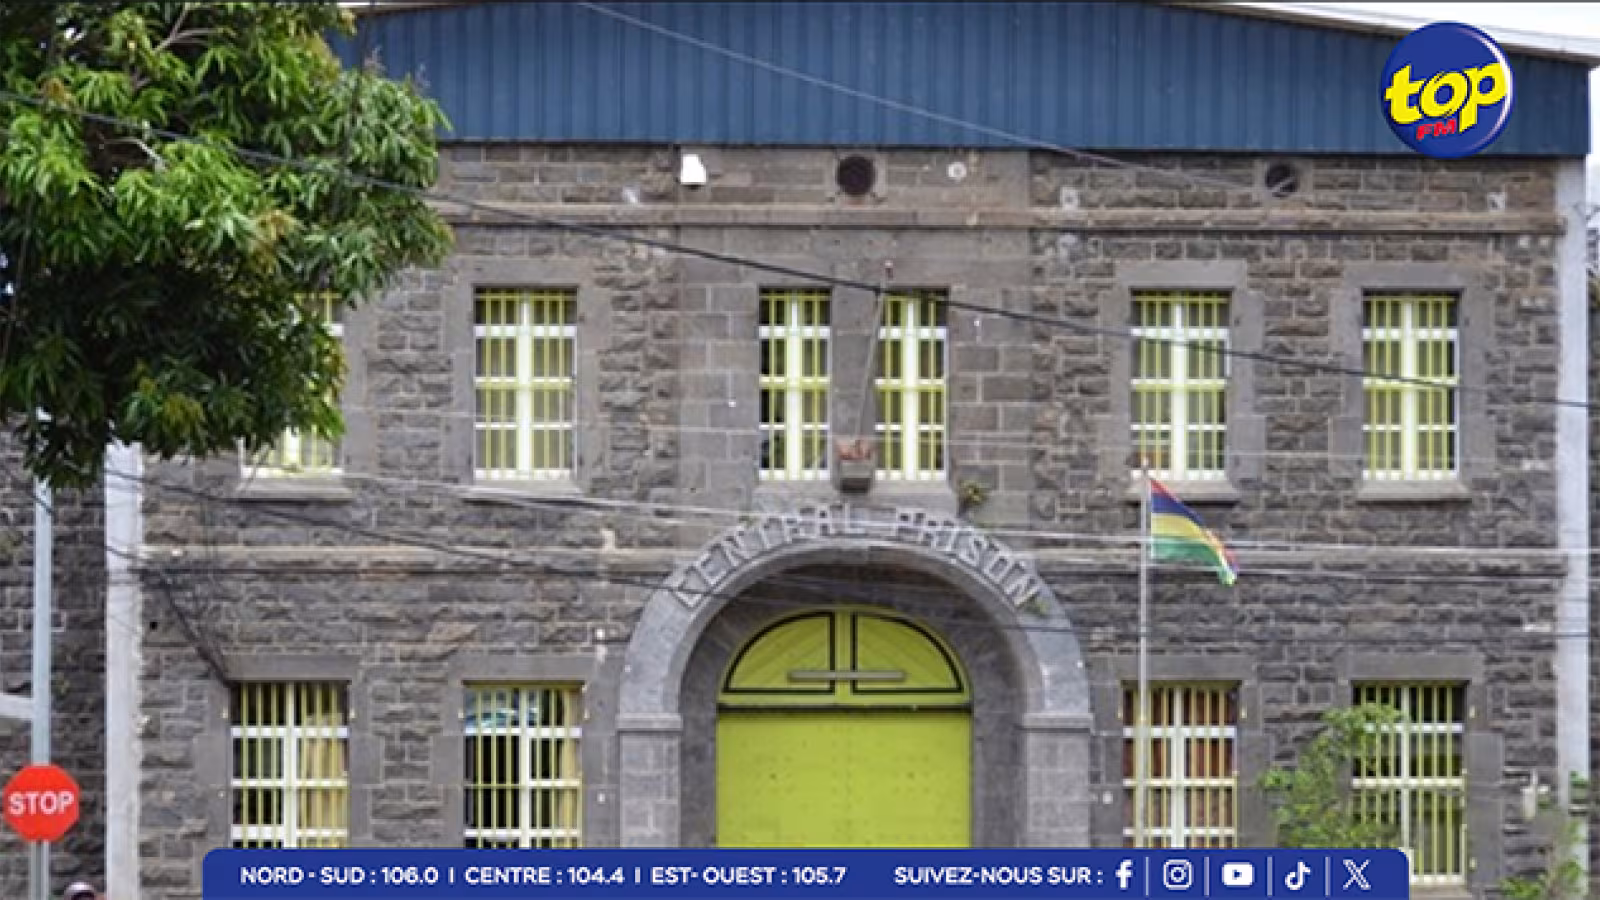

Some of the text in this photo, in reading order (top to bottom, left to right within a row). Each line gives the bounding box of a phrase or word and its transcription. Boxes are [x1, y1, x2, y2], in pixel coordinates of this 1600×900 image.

[674, 502, 1041, 609] CENTRAL PRISON
[8, 789, 75, 815] STOP
